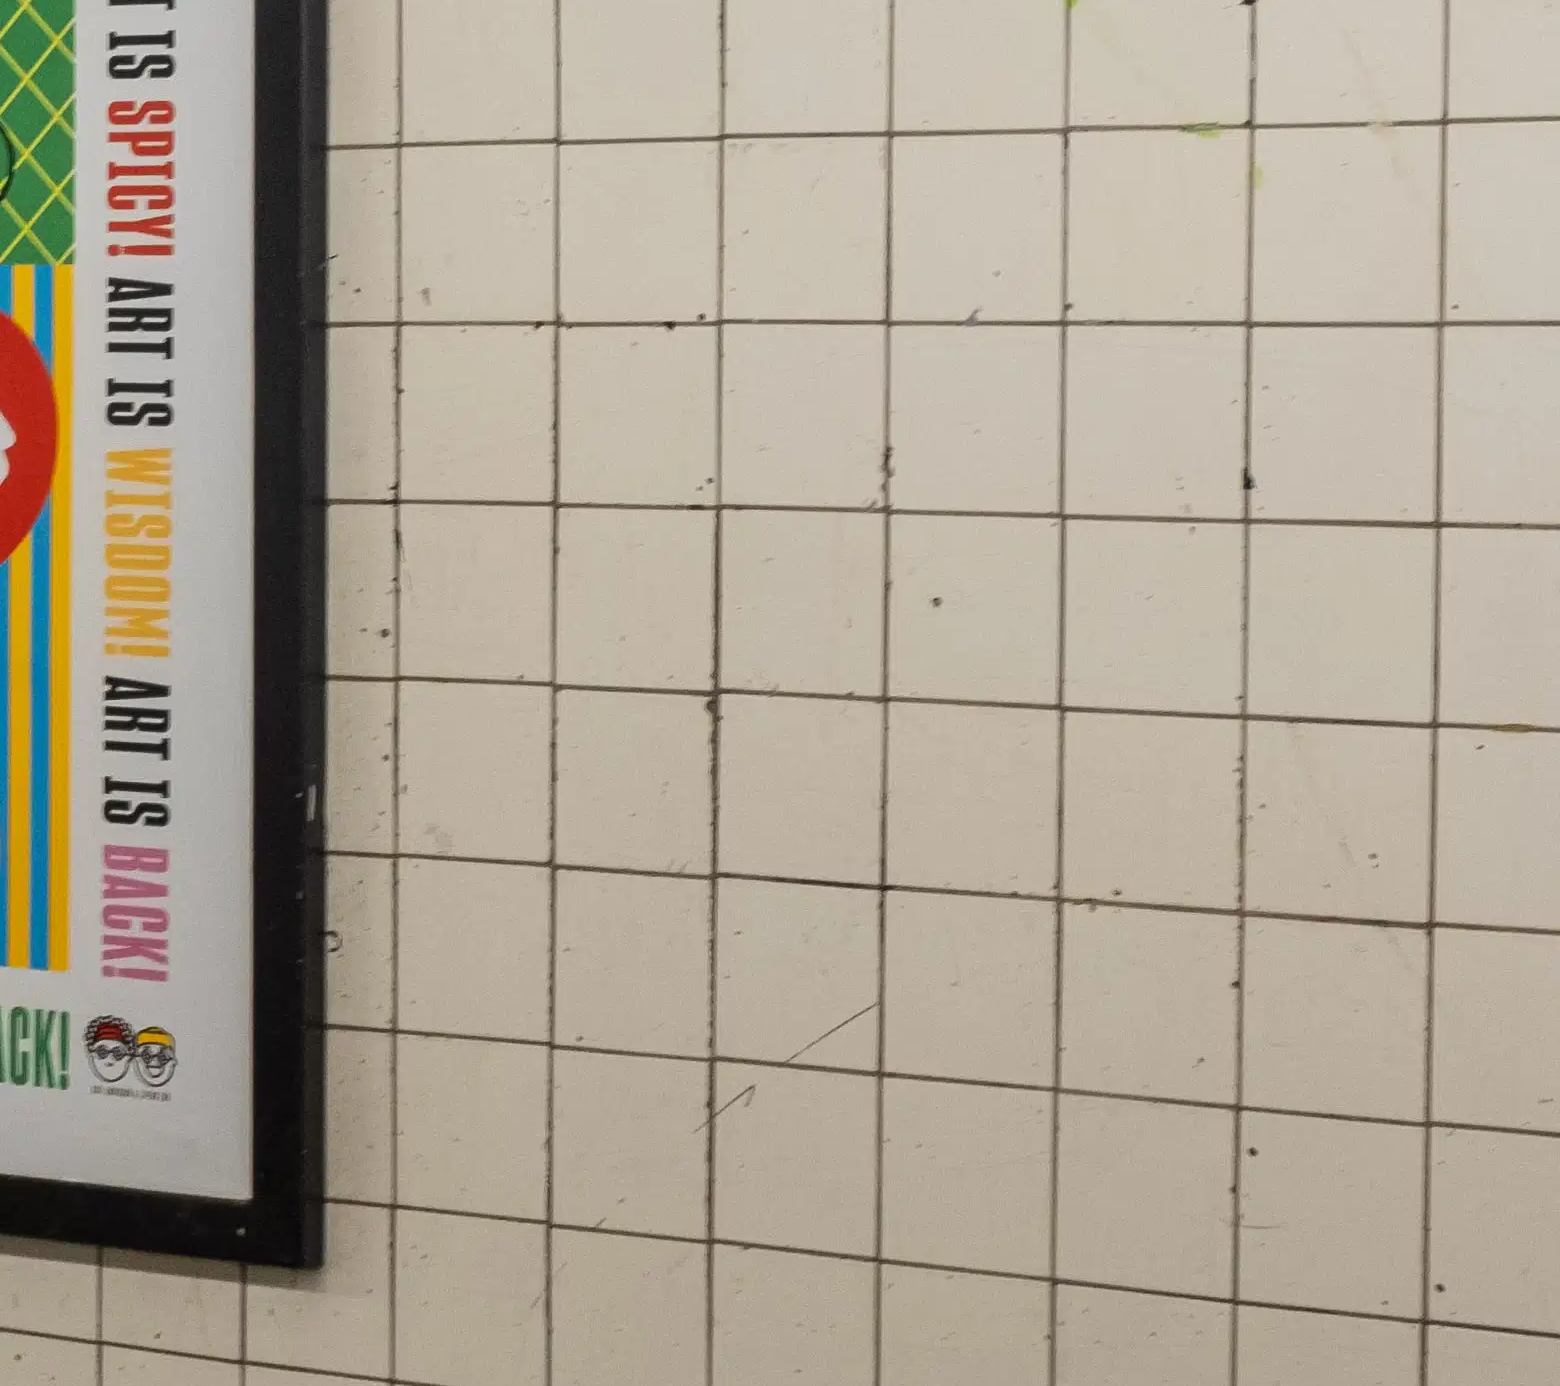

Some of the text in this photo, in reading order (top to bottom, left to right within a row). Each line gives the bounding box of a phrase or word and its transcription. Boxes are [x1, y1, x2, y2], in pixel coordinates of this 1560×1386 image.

[107, 30, 176, 79] IS
[106, 100, 175, 256] SPICY!
[106, 277, 175, 360] ART
[105, 378, 174, 426] IS
[103, 447, 173, 658] WISDOM!
[102, 675, 171, 761] ART
[101, 776, 170, 827] IS
[100, 844, 170, 982] BACK!
